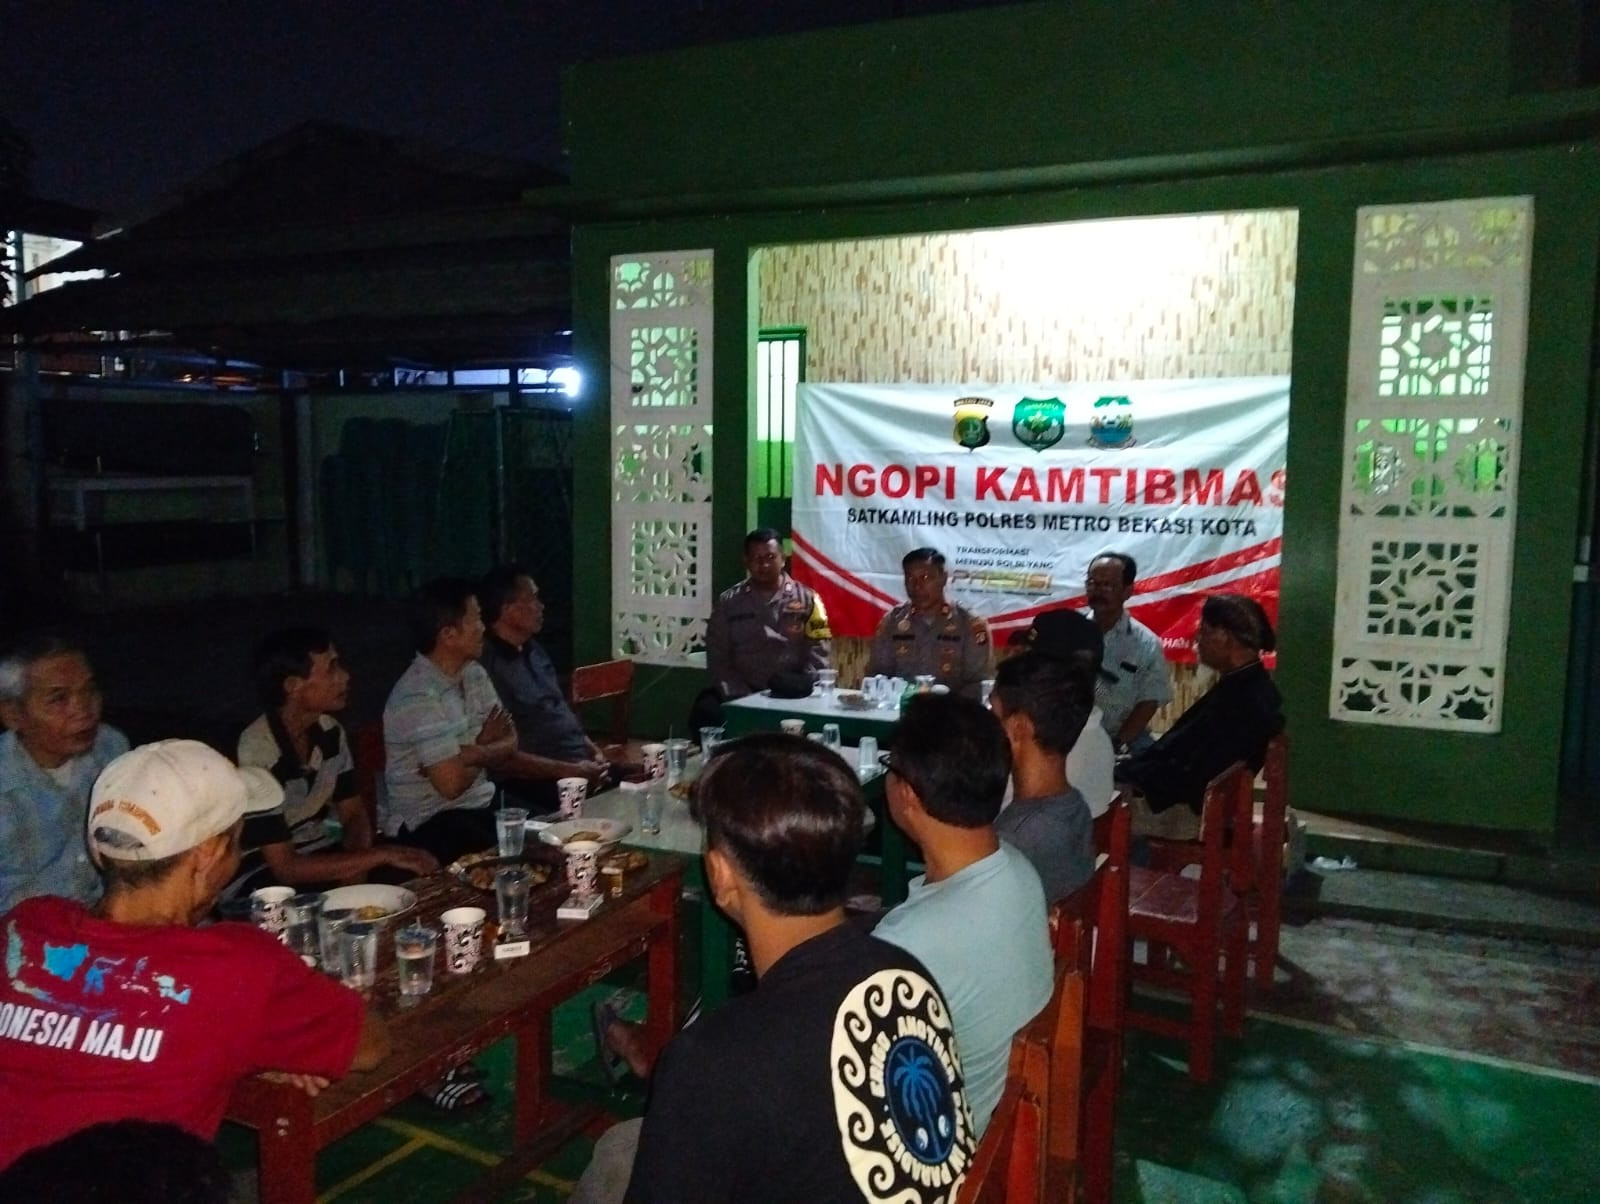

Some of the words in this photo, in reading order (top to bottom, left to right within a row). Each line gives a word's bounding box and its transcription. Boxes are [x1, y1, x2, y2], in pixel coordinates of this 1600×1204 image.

[815, 463, 956, 500] NGOPI
[847, 507, 959, 528] SATKAMLING
[964, 512, 1036, 530] POLRES
[1043, 514, 1111, 533] METRO
[1118, 517, 1194, 535] BEKASI
[1201, 518, 1257, 537] KOTA
[0, 1001, 80, 1050] ONESIA
[80, 1020, 163, 1062] MAJU
